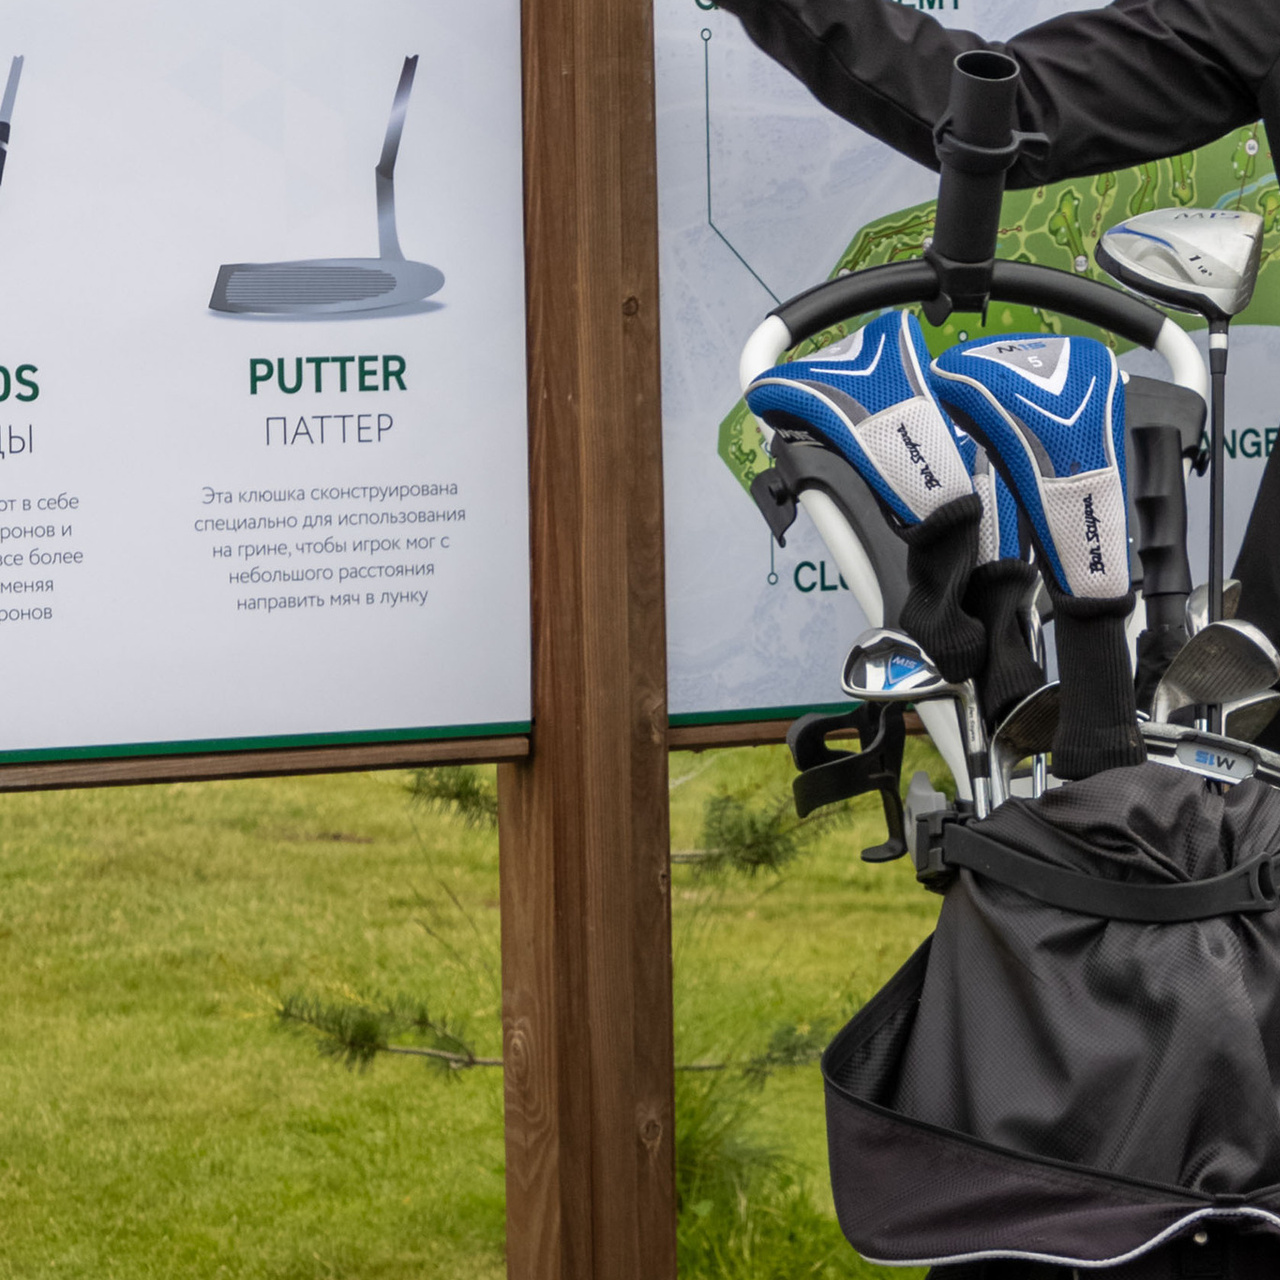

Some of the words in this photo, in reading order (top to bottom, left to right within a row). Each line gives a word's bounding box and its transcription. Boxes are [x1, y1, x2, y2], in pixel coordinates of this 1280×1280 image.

[1028, 355, 1043, 369] 5
[249, 355, 408, 395] PUTTER
[265, 414, 394, 447] ПАТТЕР
[201, 485, 234, 504] Эта
[238, 487, 306, 503] клюшка
[309, 481, 459, 502] сконструирована
[193, 514, 299, 532] специально
[301, 512, 333, 530] для
[337, 507, 466, 526] использования
[212, 543, 233, 557] на
[237, 541, 293, 561] грине,
[295, 534, 348, 554] чтобы
[352, 536, 402, 555] игрок
[405, 535, 436, 550] мог
[439, 534, 450, 548] с
[228, 564, 334, 584] небольшого
[338, 562, 435, 583] расстояния
[236, 593, 326, 613] направить
[329, 592, 361, 606] мяч
[365, 591, 376, 605] в
[379, 588, 429, 608] лунку
